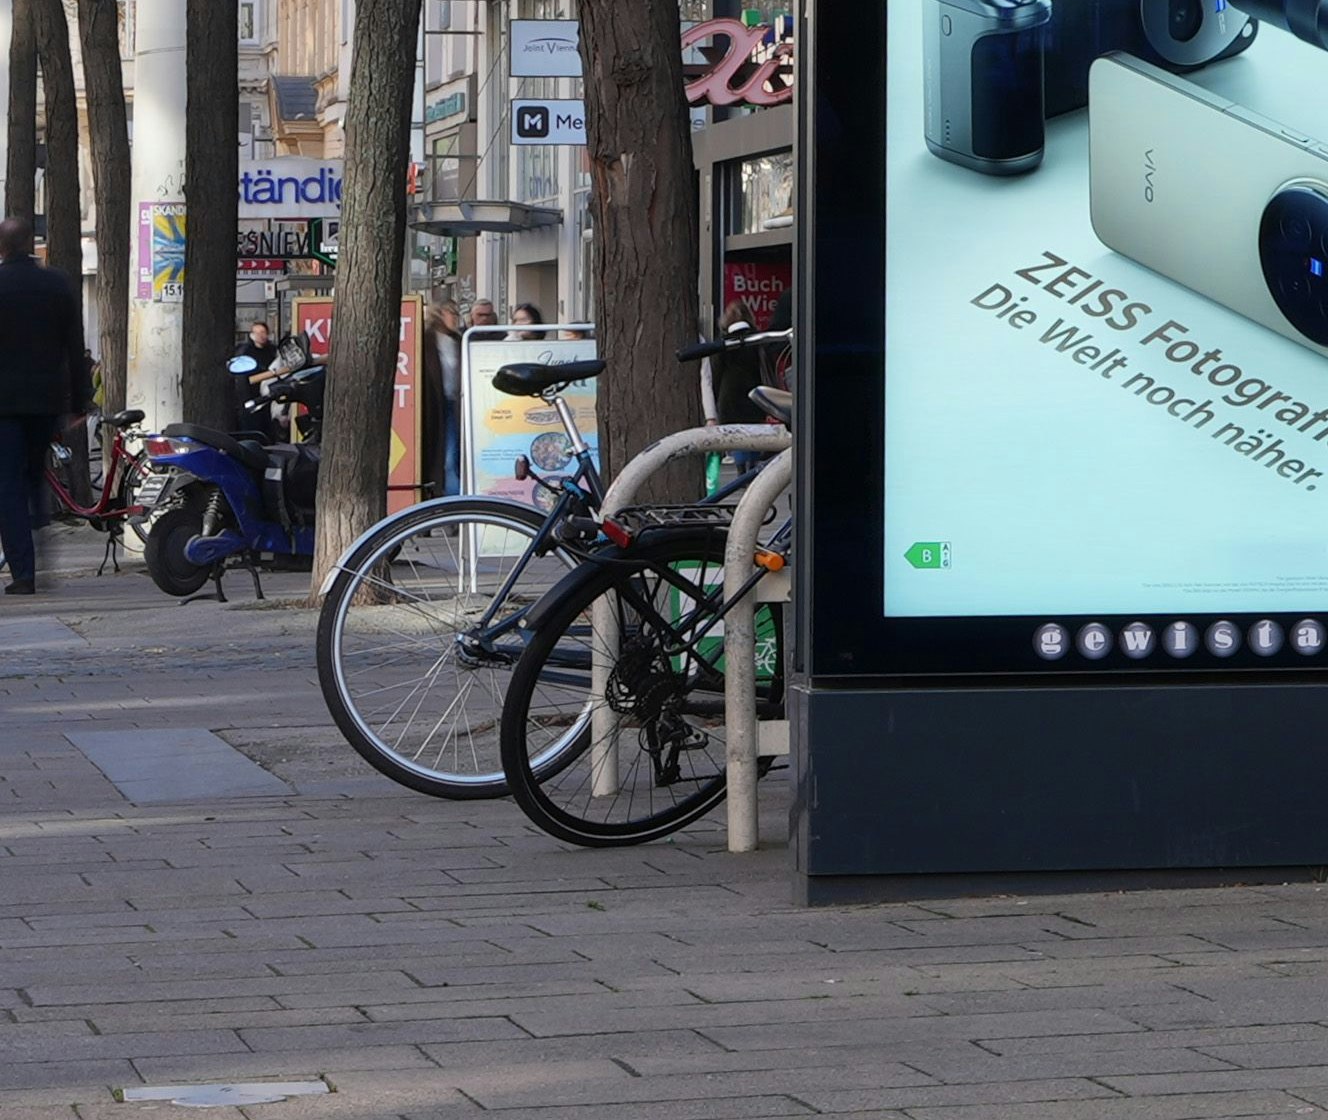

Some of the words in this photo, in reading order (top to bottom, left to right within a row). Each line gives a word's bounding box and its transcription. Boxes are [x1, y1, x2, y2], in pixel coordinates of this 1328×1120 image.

[239, 167, 343, 211] tändi
[733, 275, 784, 292] Buch
[1013, 250, 1153, 332] ZEISS
[741, 295, 781, 312] Wie
[969, 282, 1038, 330] Die
[1038, 317, 1129, 379] Welt
[1121, 371, 1216, 430] noch
[1211, 420, 1324, 492] näher.
[922, 549, 932, 564] B
[1040, 621, 1321, 655] gewista
